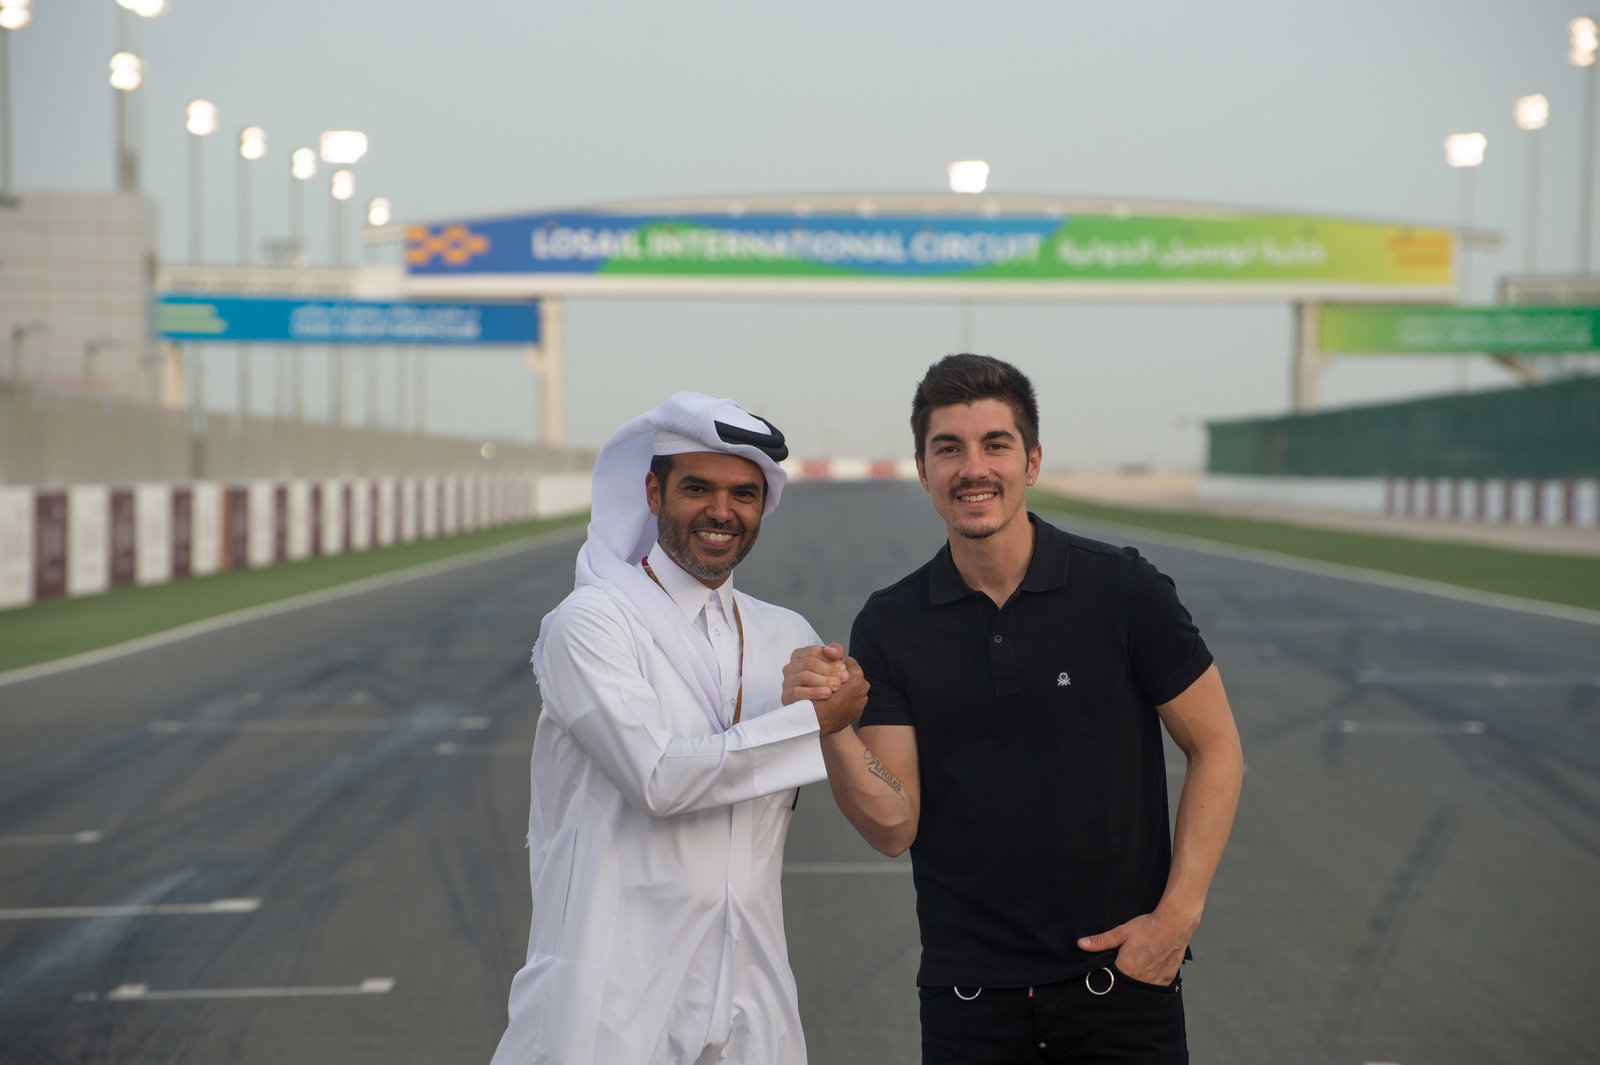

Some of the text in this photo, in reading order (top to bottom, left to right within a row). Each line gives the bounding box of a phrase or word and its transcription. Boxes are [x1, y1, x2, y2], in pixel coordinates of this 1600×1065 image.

[531, 227, 1043, 266] LOSAIL INTERNATIONAL CIRCUIT
